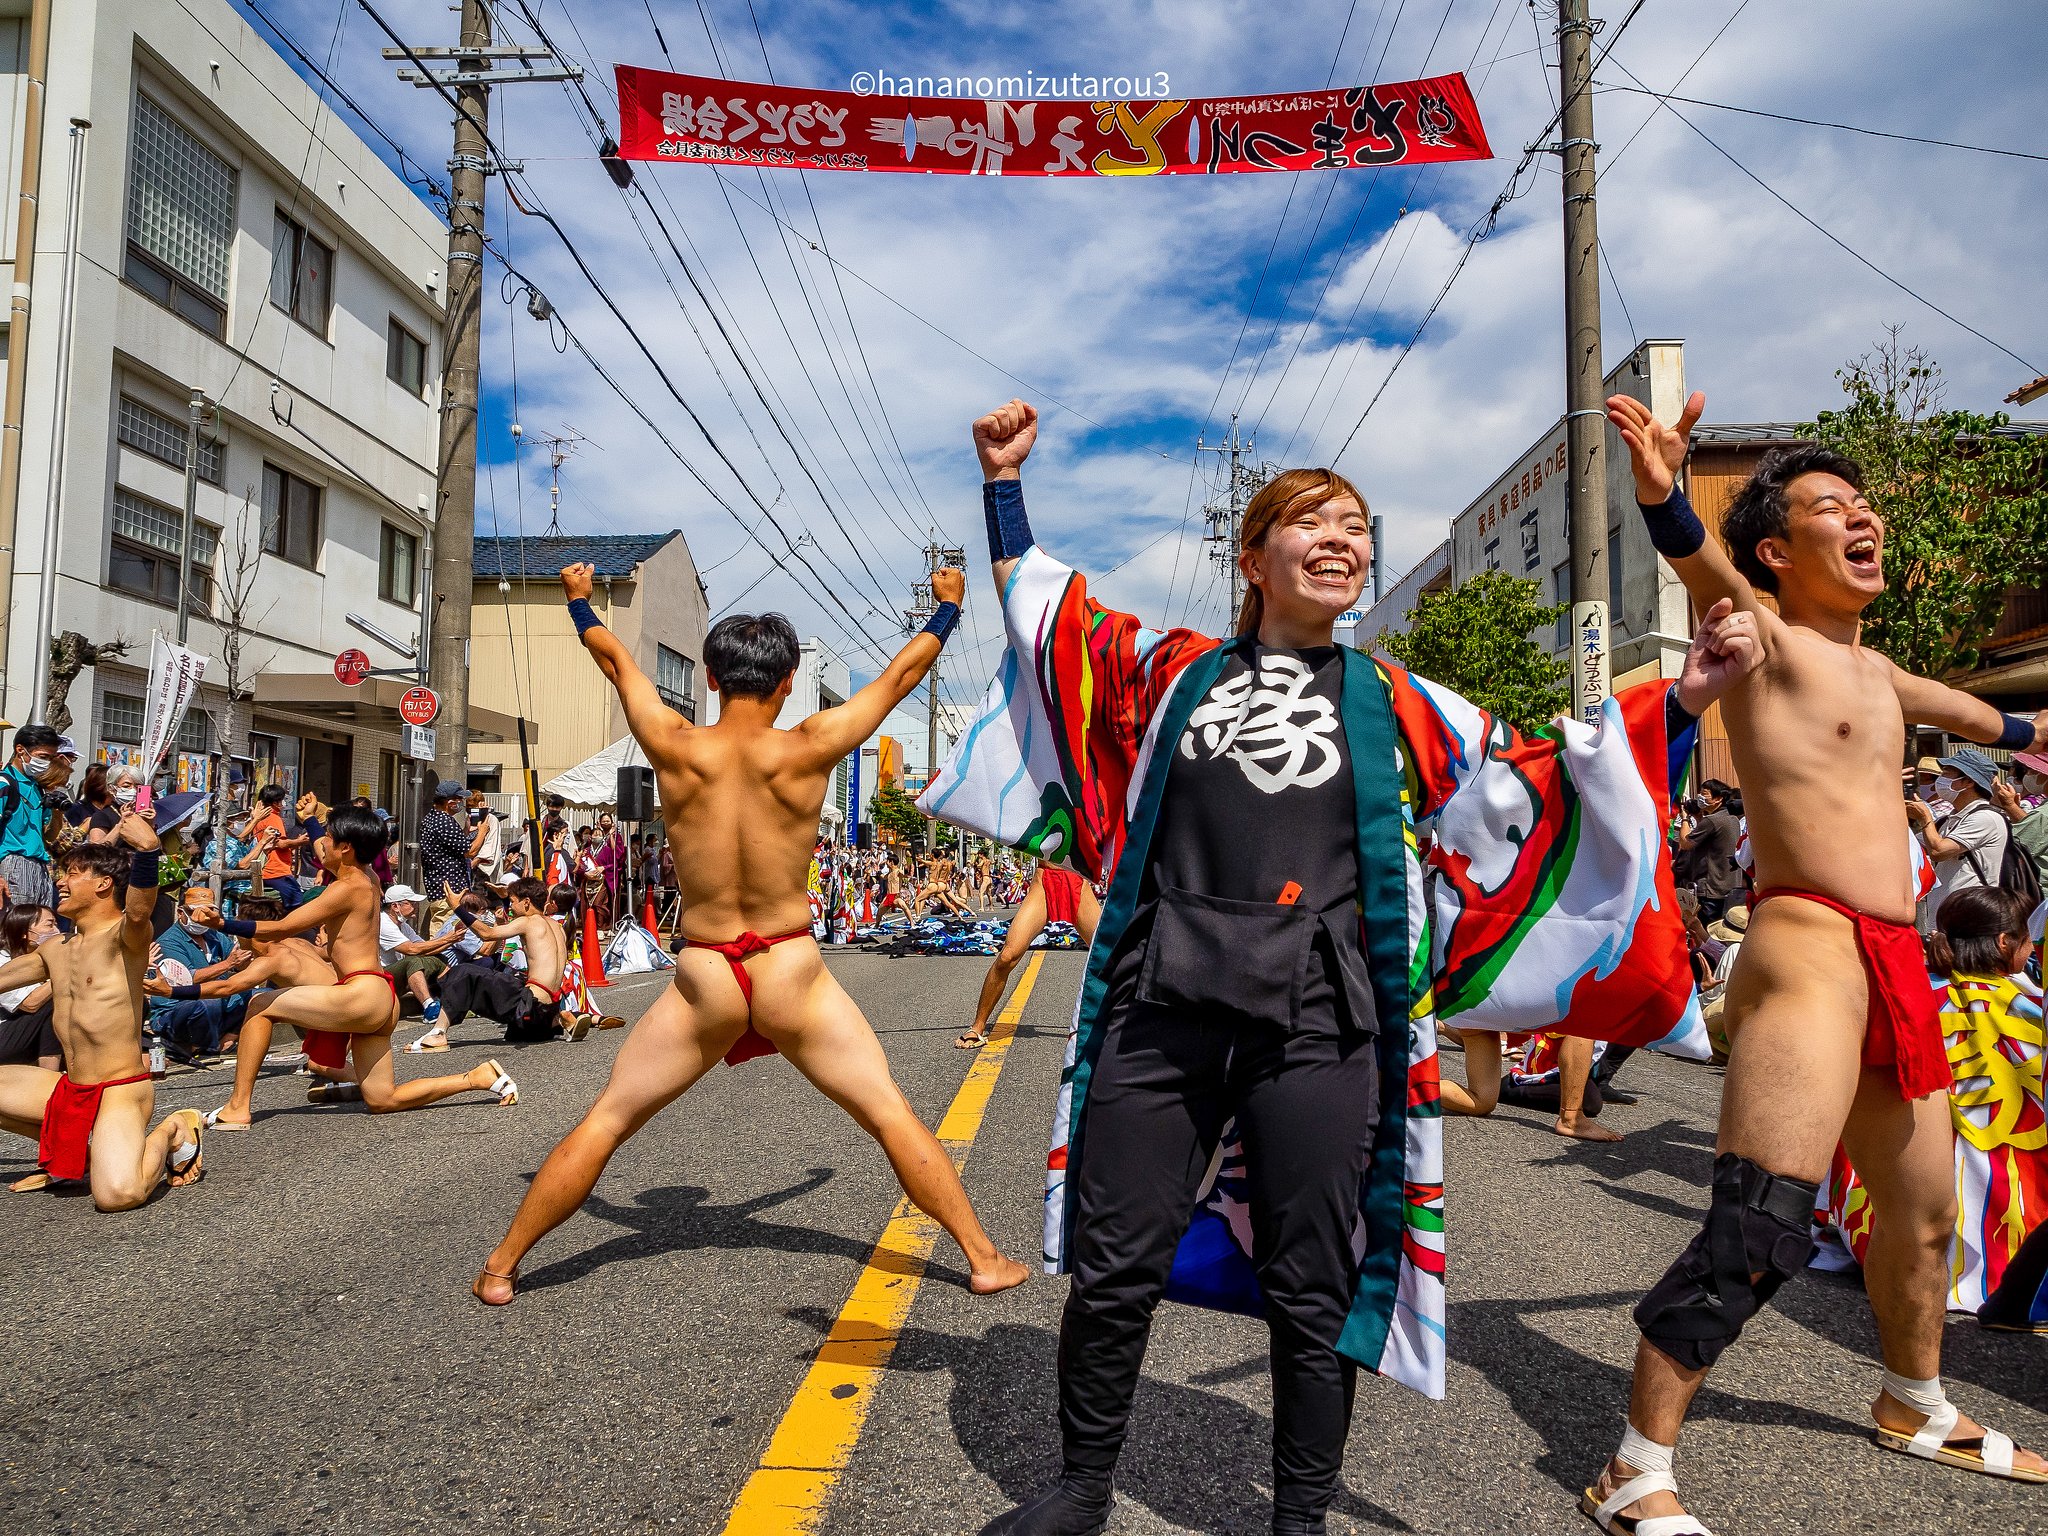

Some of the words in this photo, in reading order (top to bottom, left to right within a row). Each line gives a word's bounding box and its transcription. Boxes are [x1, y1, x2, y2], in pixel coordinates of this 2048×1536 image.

[338, 661, 366, 672] 市バス
[1582, 629, 1603, 731] 湯木どうぶつ病院
[404, 700, 432, 711] 市バス
